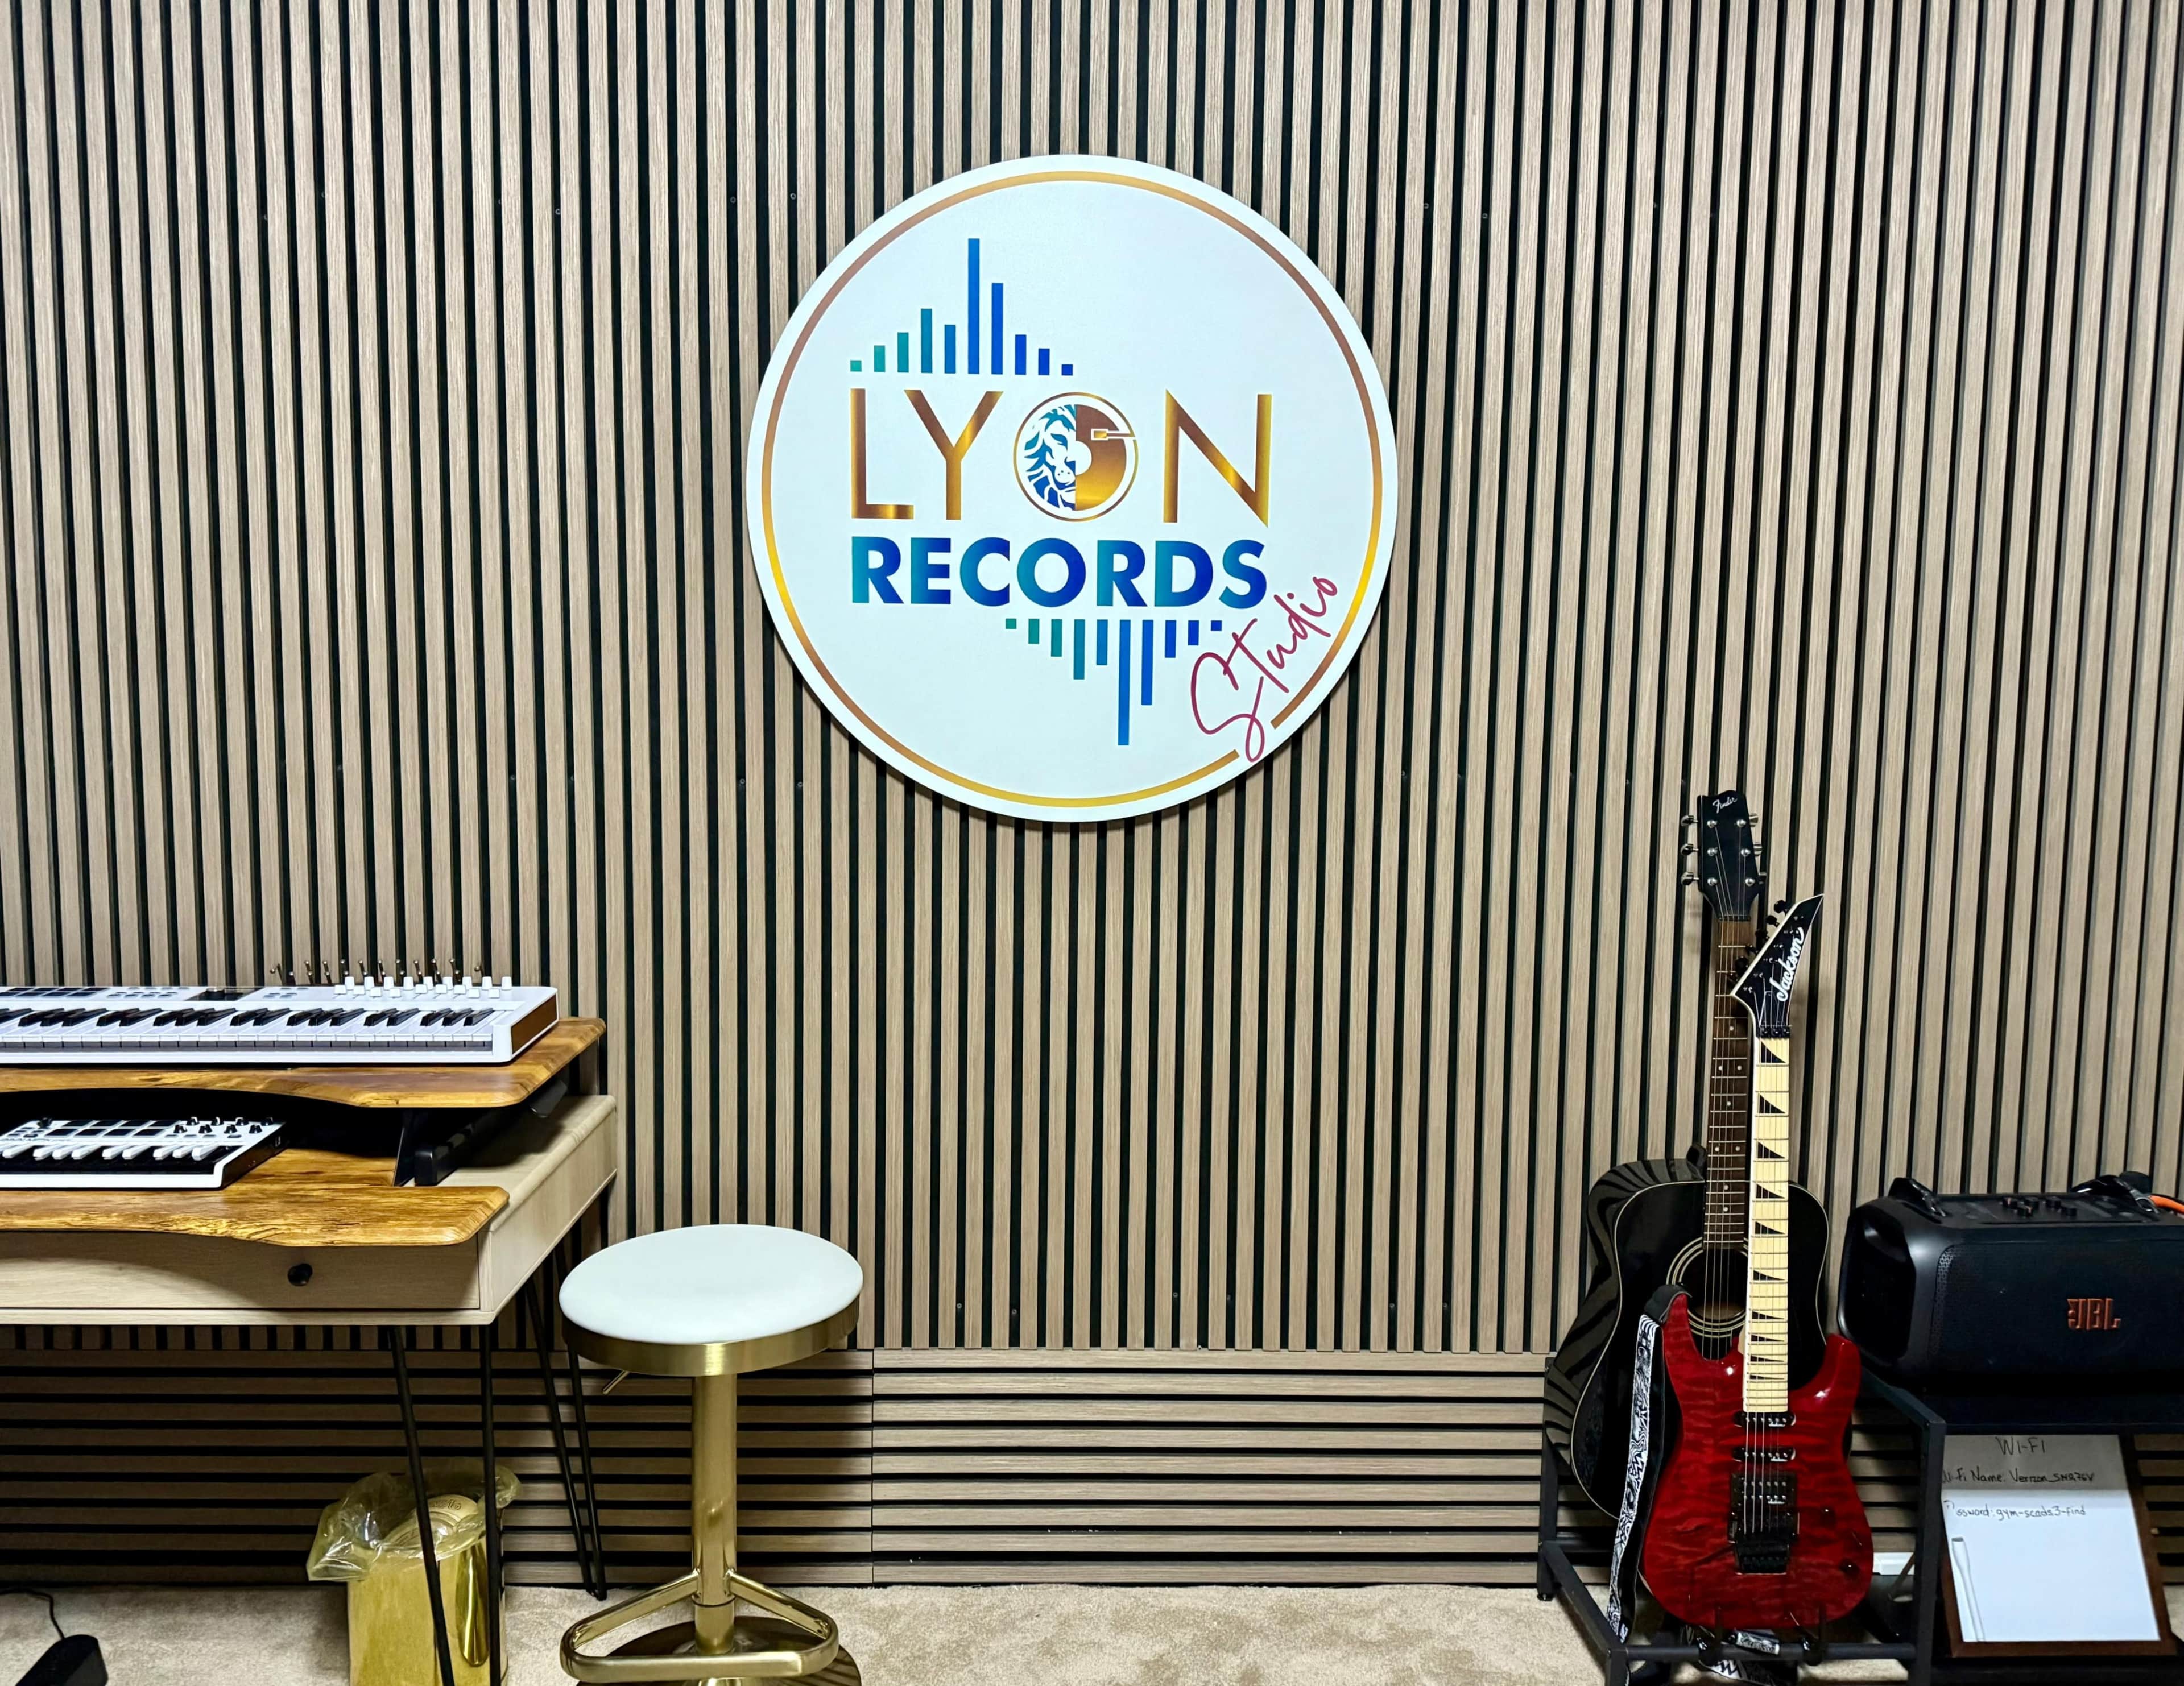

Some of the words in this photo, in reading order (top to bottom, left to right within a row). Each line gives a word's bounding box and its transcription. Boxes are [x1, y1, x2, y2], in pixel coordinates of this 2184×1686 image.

[850, 388, 1272, 527] LYON
[851, 536, 1268, 610] RECORDS
[1190, 576, 1338, 763] Studio
[1712, 796, 1738, 814] Fender
[1769, 927, 1805, 1002] Jackson
[2066, 1298, 2121, 1330] JBL
